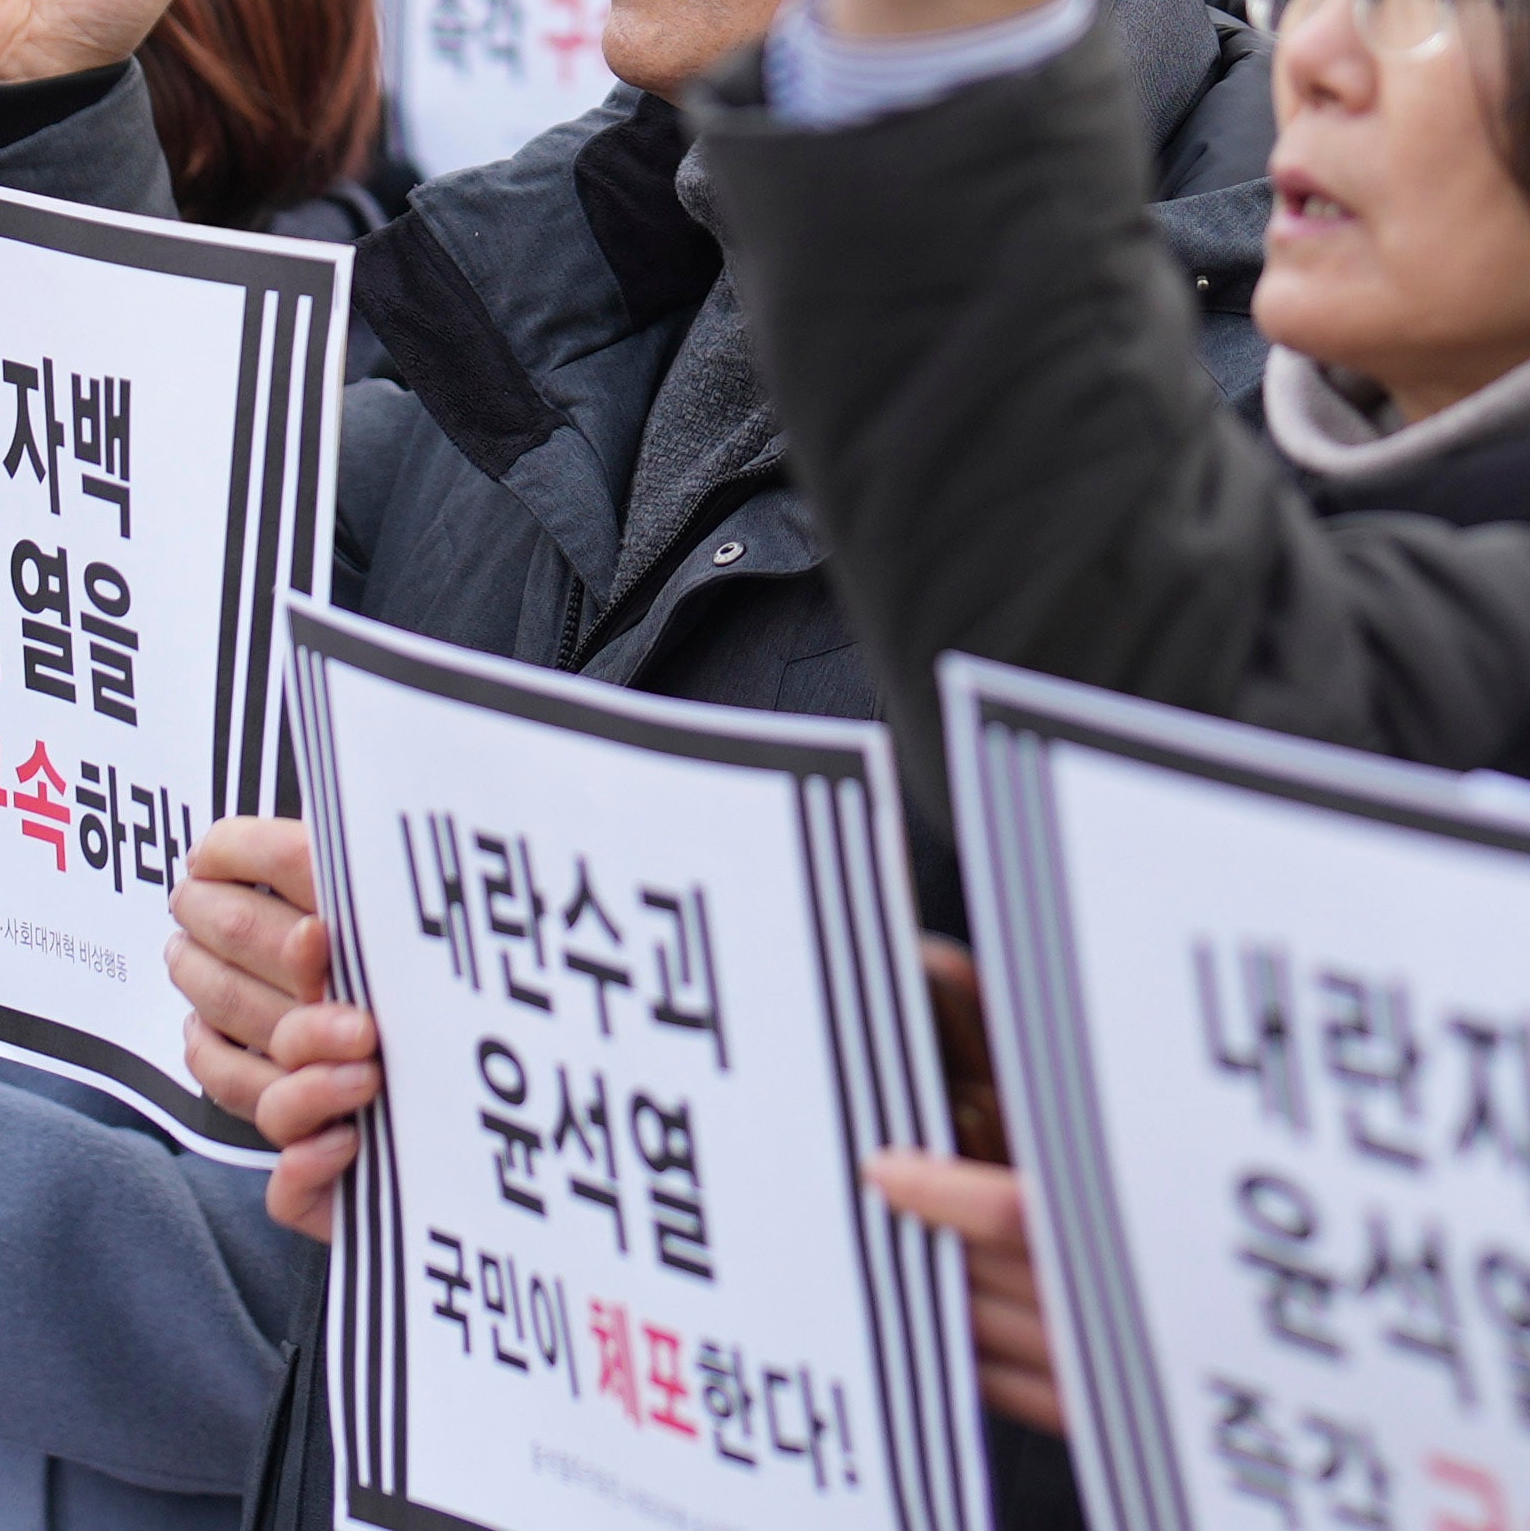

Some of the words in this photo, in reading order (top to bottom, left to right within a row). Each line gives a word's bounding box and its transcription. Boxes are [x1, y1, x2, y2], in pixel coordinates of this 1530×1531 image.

[79, 940, 128, 984] 비상행동
[399, 810, 732, 1074] 내란수괴
[475, 1034, 716, 1282] 윤석열
[424, 1226, 581, 1401] 국민이
[588, 1292, 861, 1492] 체포한다!
